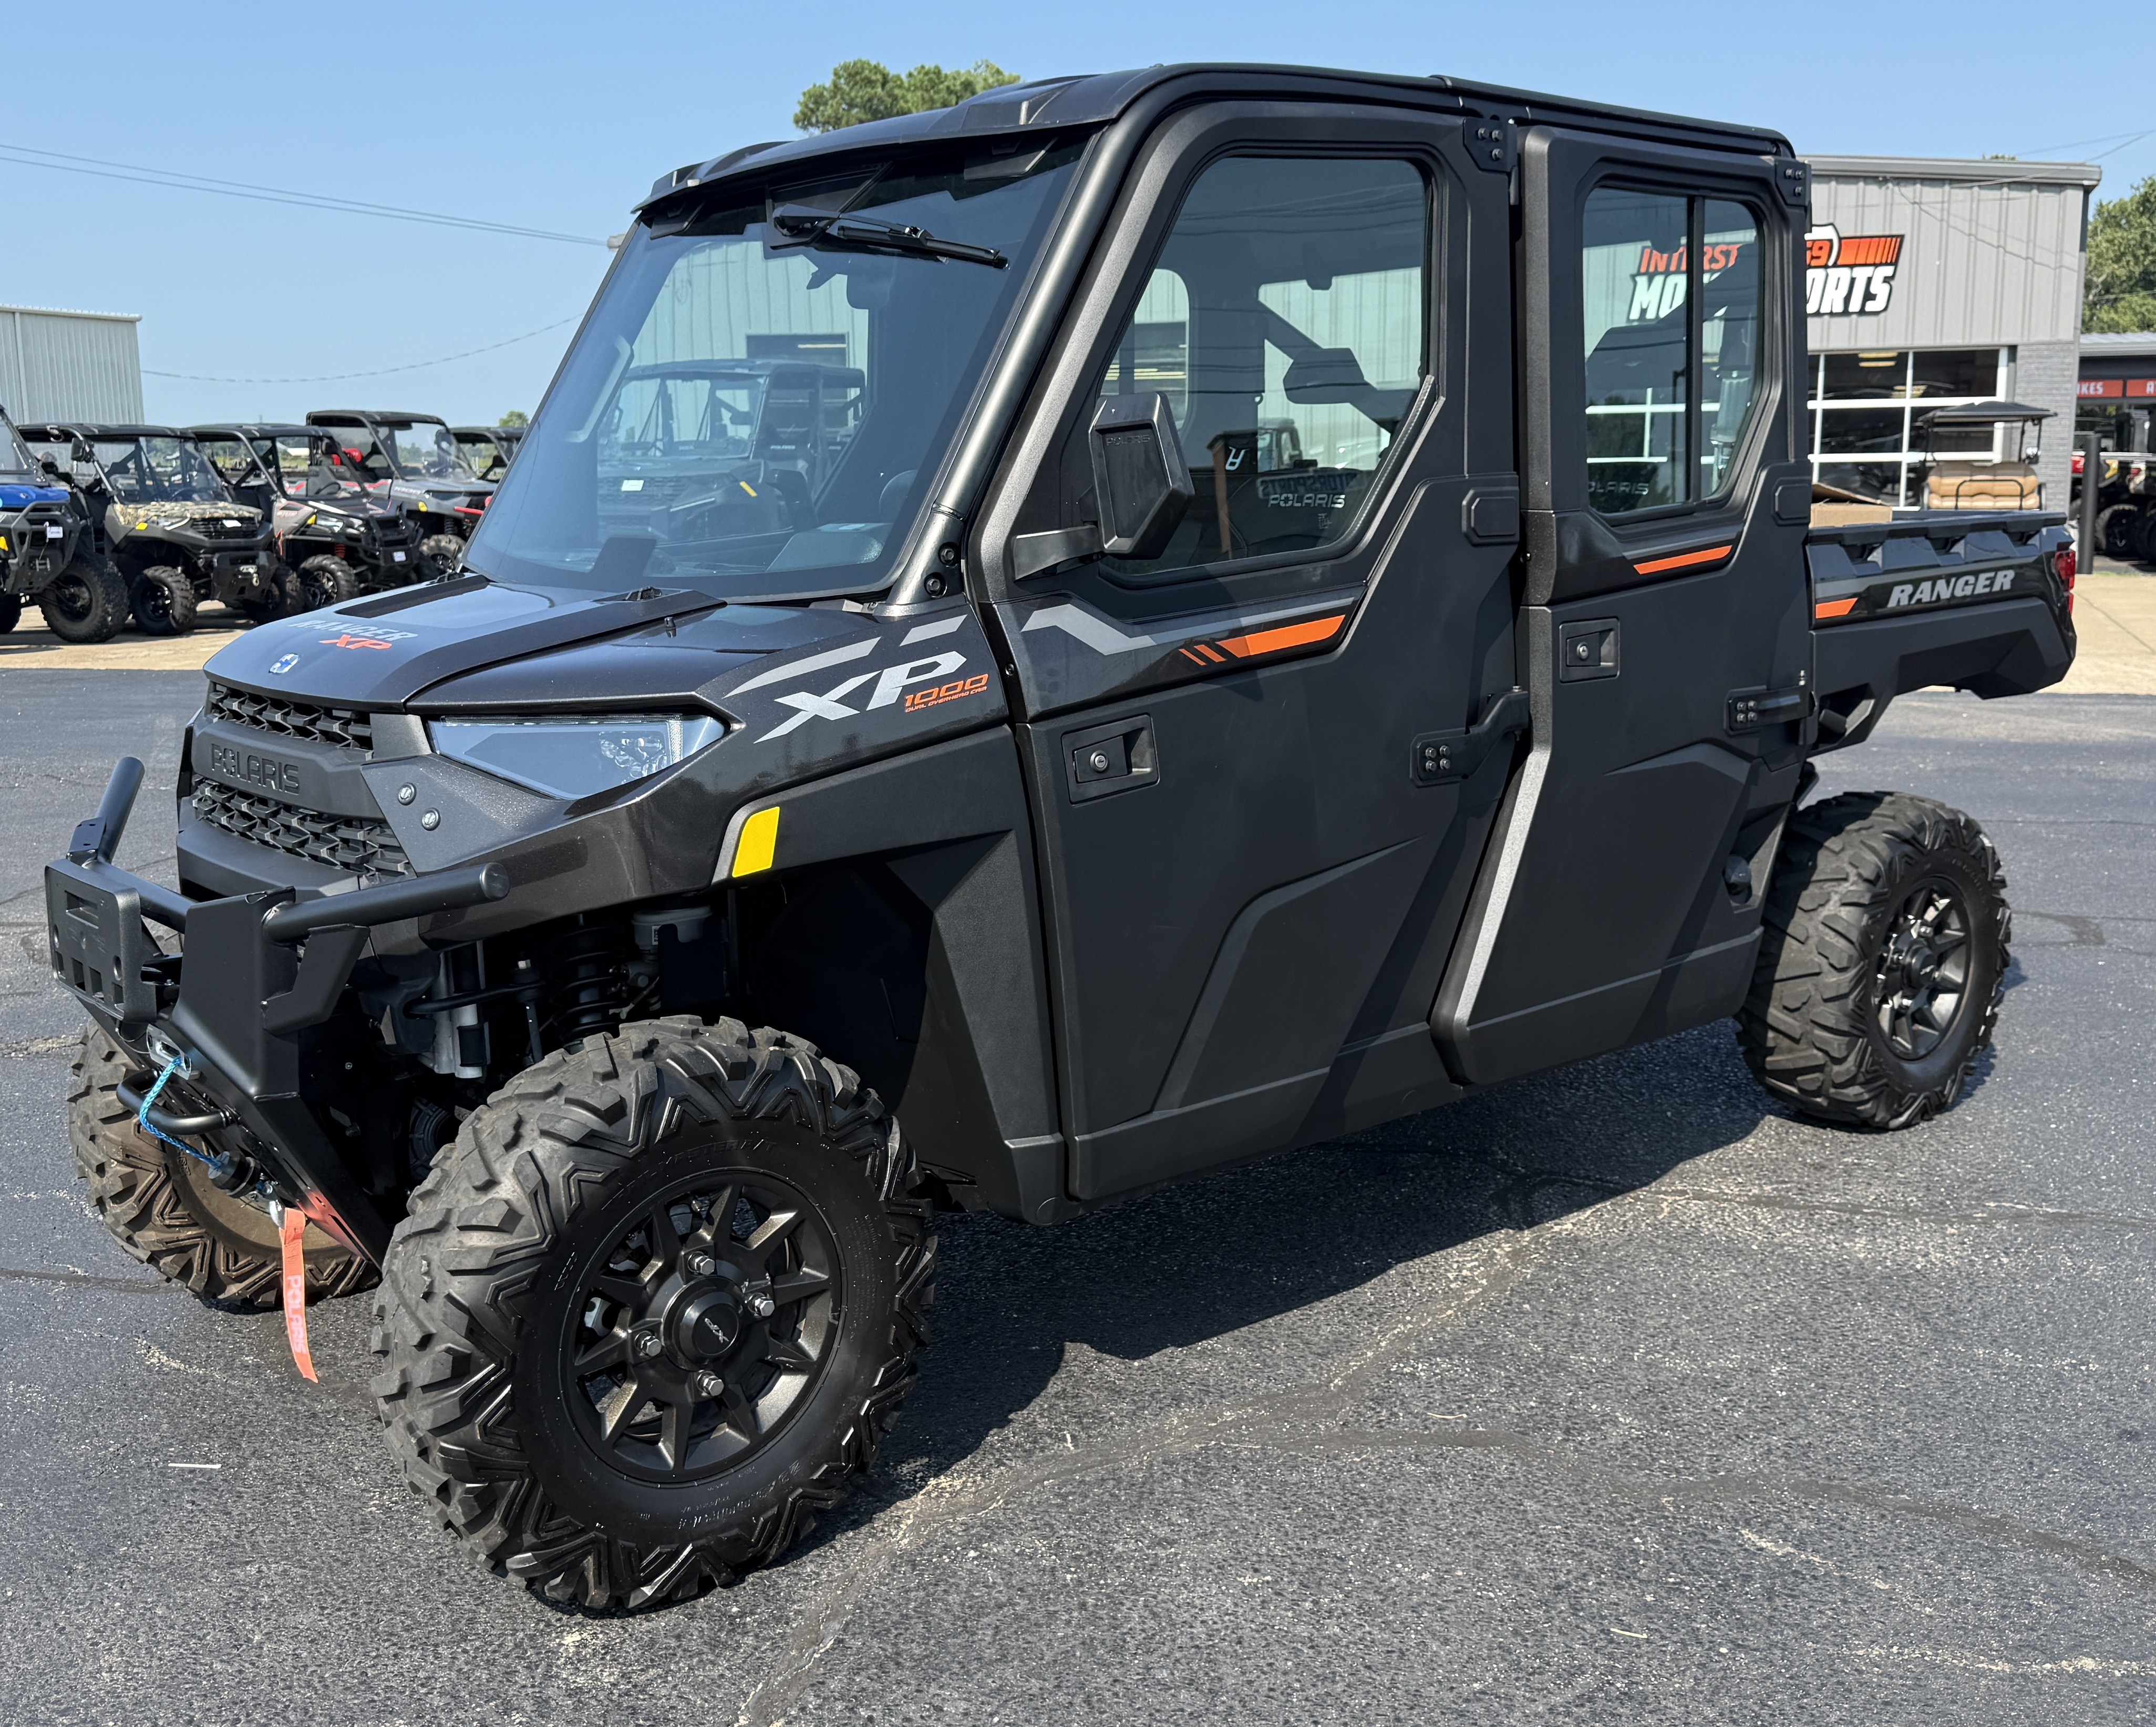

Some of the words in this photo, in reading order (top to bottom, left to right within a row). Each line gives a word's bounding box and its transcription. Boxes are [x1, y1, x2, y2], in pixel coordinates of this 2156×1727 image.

[1106, 434, 1150, 447] POLARIS
[1268, 494, 1345, 508] POLARIS
[1588, 481, 1649, 495] OLARIS
[1887, 569, 2015, 608] RANGER
[288, 620, 418, 641] RANGER
[318, 634, 393, 650] XP
[754, 651, 967, 743] XP
[905, 673, 989, 706] 1000
[905, 704, 926, 713] DUAL
[928, 691, 969, 706] OVERHEAD
[971, 686, 987, 695] CAM
[211, 744, 300, 795] POLARIS
[286, 1275, 307, 1354] POLARIS
